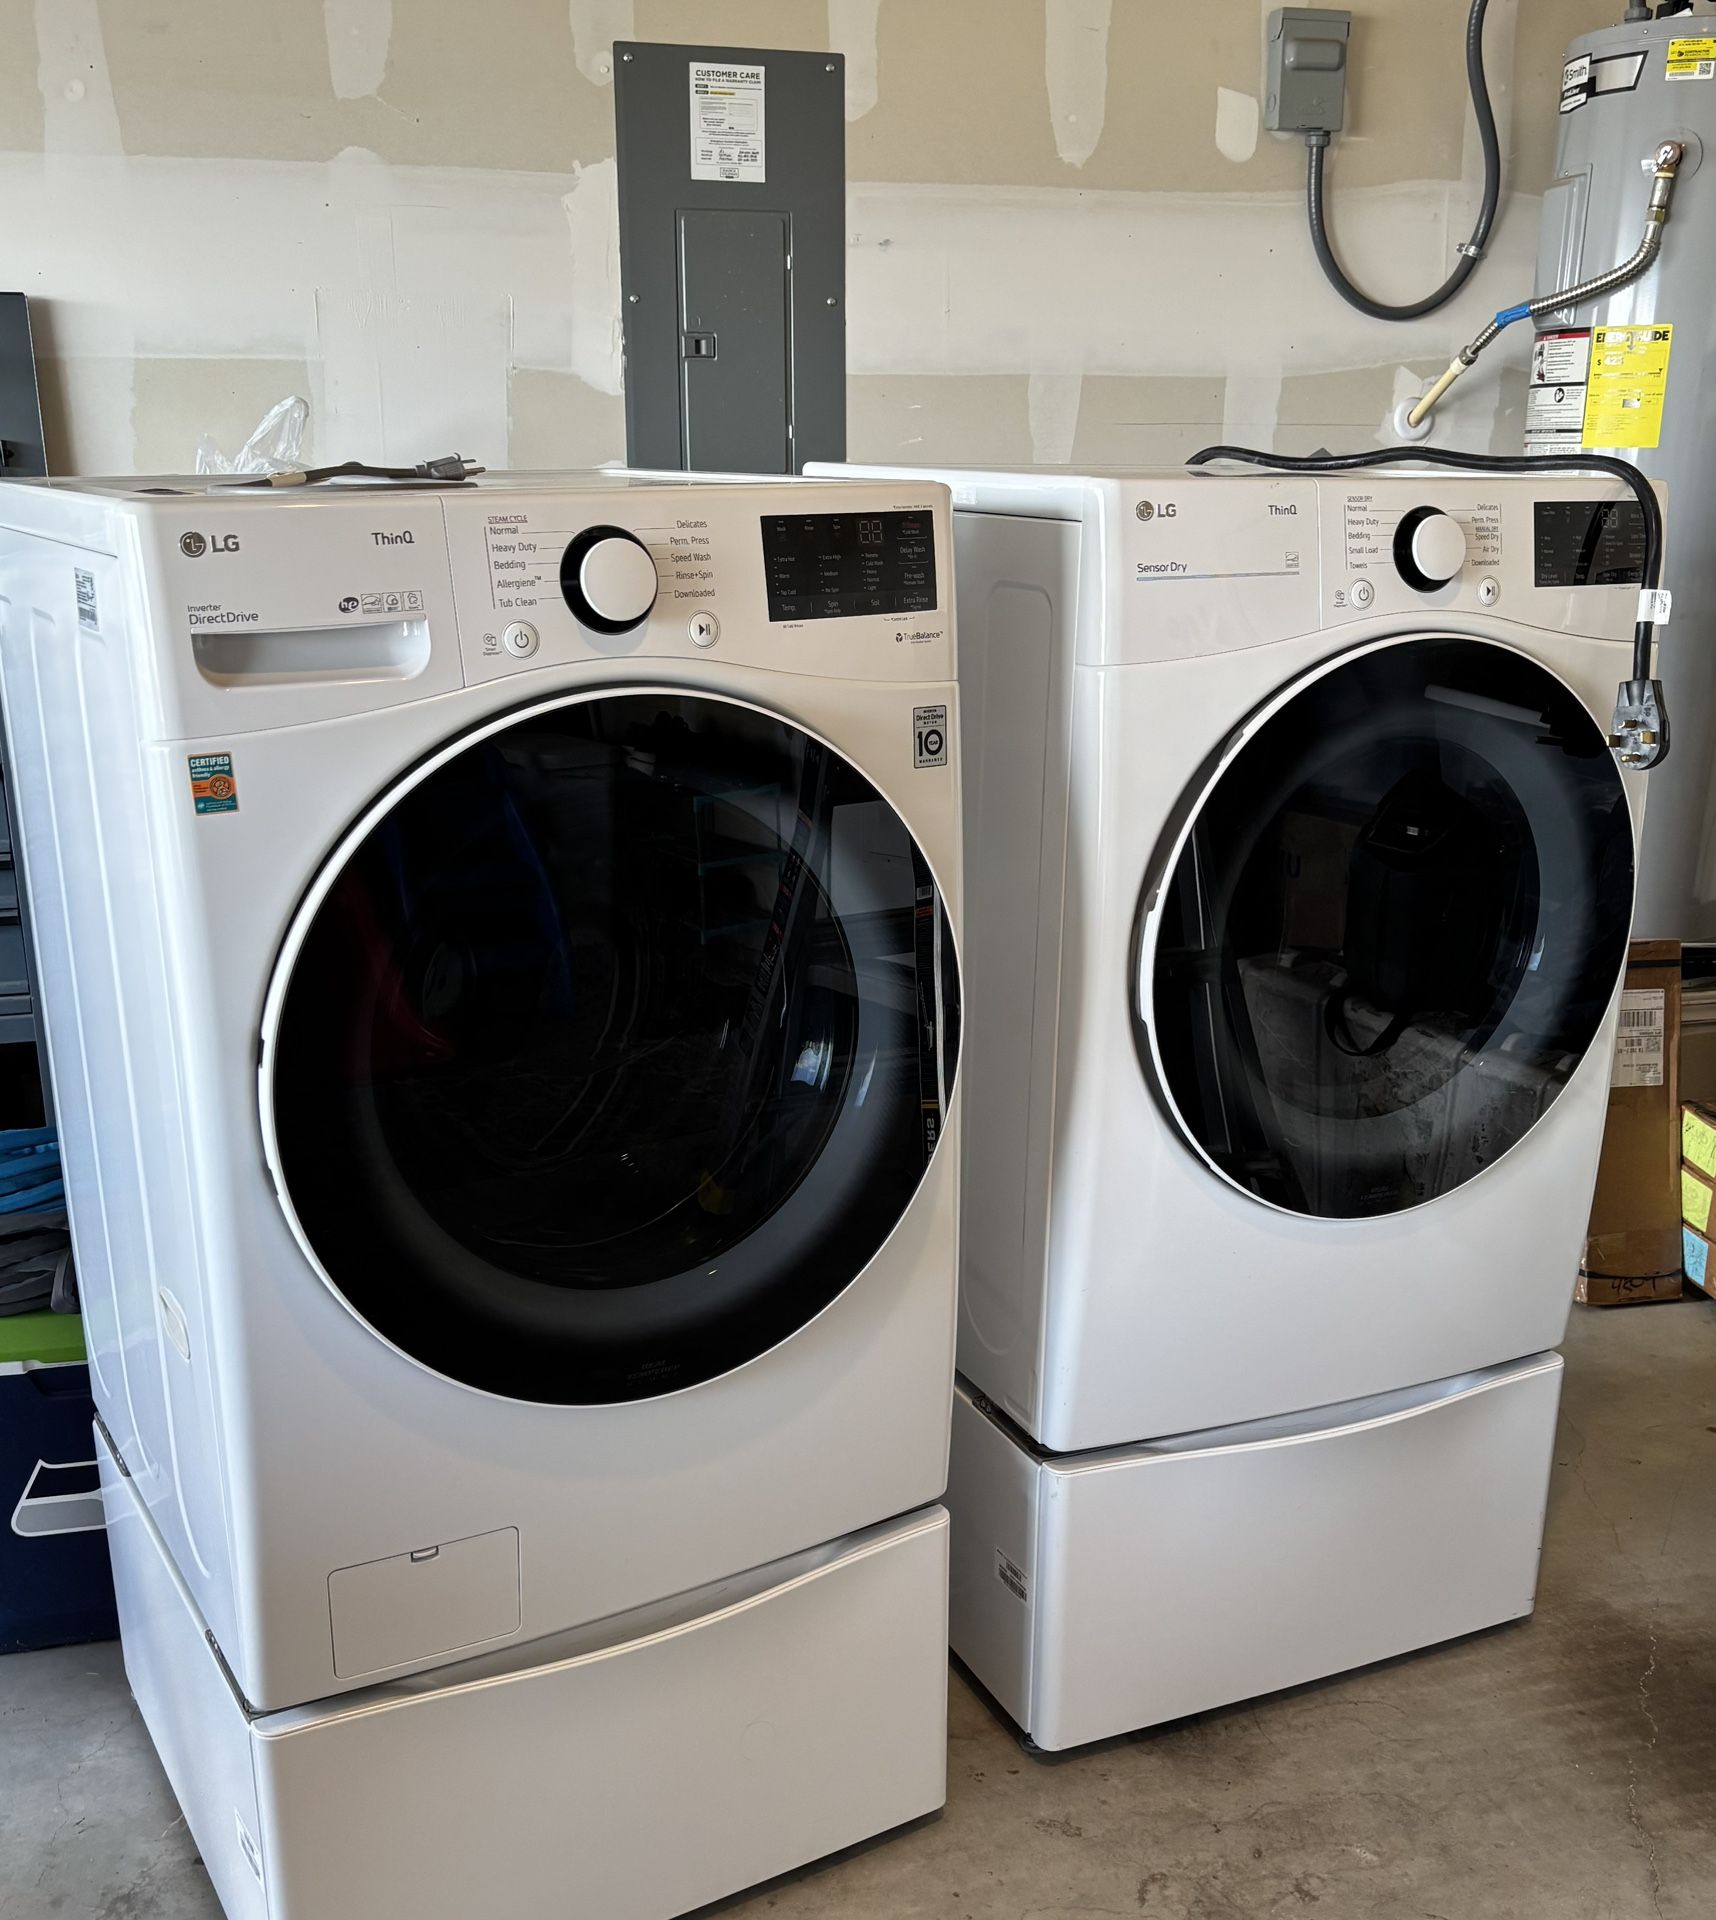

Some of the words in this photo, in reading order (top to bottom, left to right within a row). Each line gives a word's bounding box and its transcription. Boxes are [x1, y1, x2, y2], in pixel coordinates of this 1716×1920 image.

[696, 70, 738, 79] CUSTOMER
[740, 72, 761, 80] CARE
[1157, 503, 1177, 518] LG
[1267, 504, 1298, 516] ThinQ
[508, 515, 528, 523] CYCLE
[1366, 518, 1379, 526] Duty
[676, 520, 708, 529] Delicates
[490, 526, 519, 535] Normal
[371, 530, 415, 546] ThinQ
[690, 536, 710, 545] Press
[1348, 532, 1371, 540] Bedding
[1490, 533, 1499, 541] Dry
[211, 534, 240, 553] LG
[492, 544, 516, 554] Heavy
[518, 543, 537, 553] Duty
[1490, 546, 1499, 554] Dry
[671, 553, 692, 563] Speed
[694, 552, 711, 561] Wash
[494, 561, 526, 571] Bedding
[676, 570, 714, 580] Rinse+Spin
[674, 588, 716, 599] Downloaded
[187, 603, 221, 613] Inverter
[498, 599, 513, 608] Tub
[515, 598, 537, 607] Clean
[827, 600, 839, 609] Spin
[917, 729, 943, 757] 10
[190, 756, 230, 767] CERTIFIED
